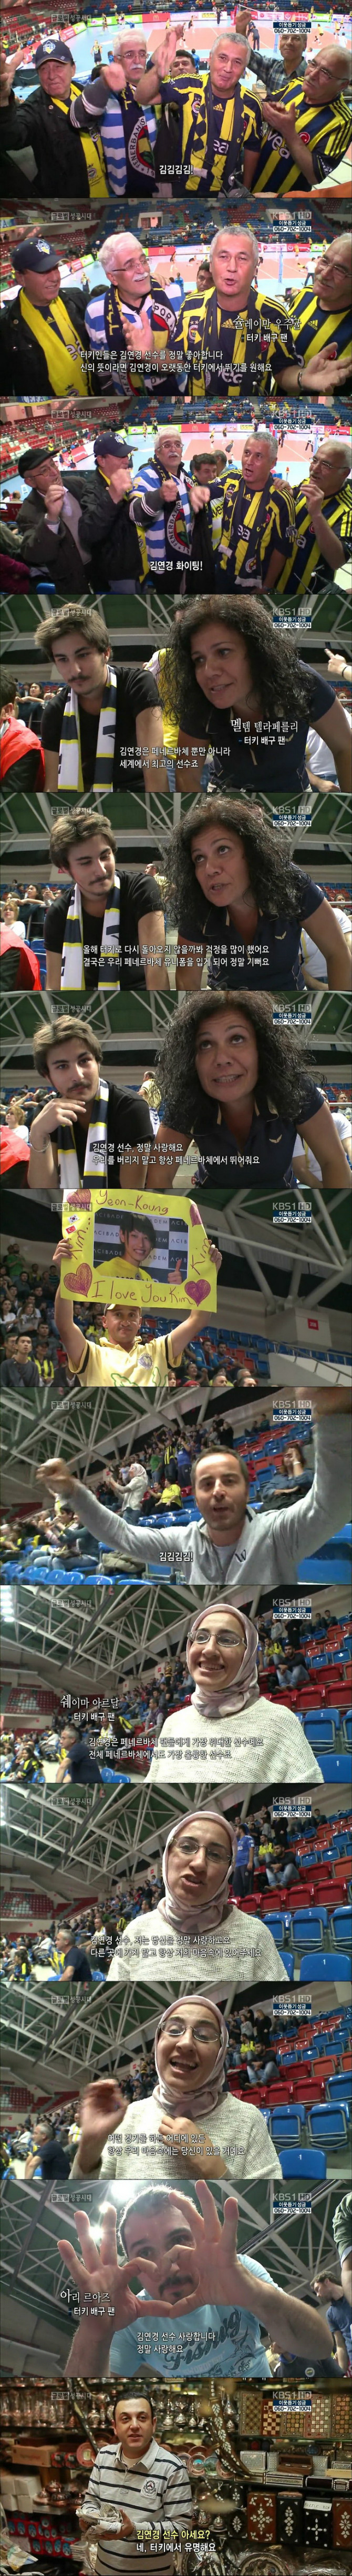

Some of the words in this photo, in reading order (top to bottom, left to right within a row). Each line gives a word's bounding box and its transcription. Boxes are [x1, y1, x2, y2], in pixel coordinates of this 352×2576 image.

[91, 1281, 106, 1298] I
[110, 1281, 137, 1300] love
[142, 1284, 166, 1306] You
